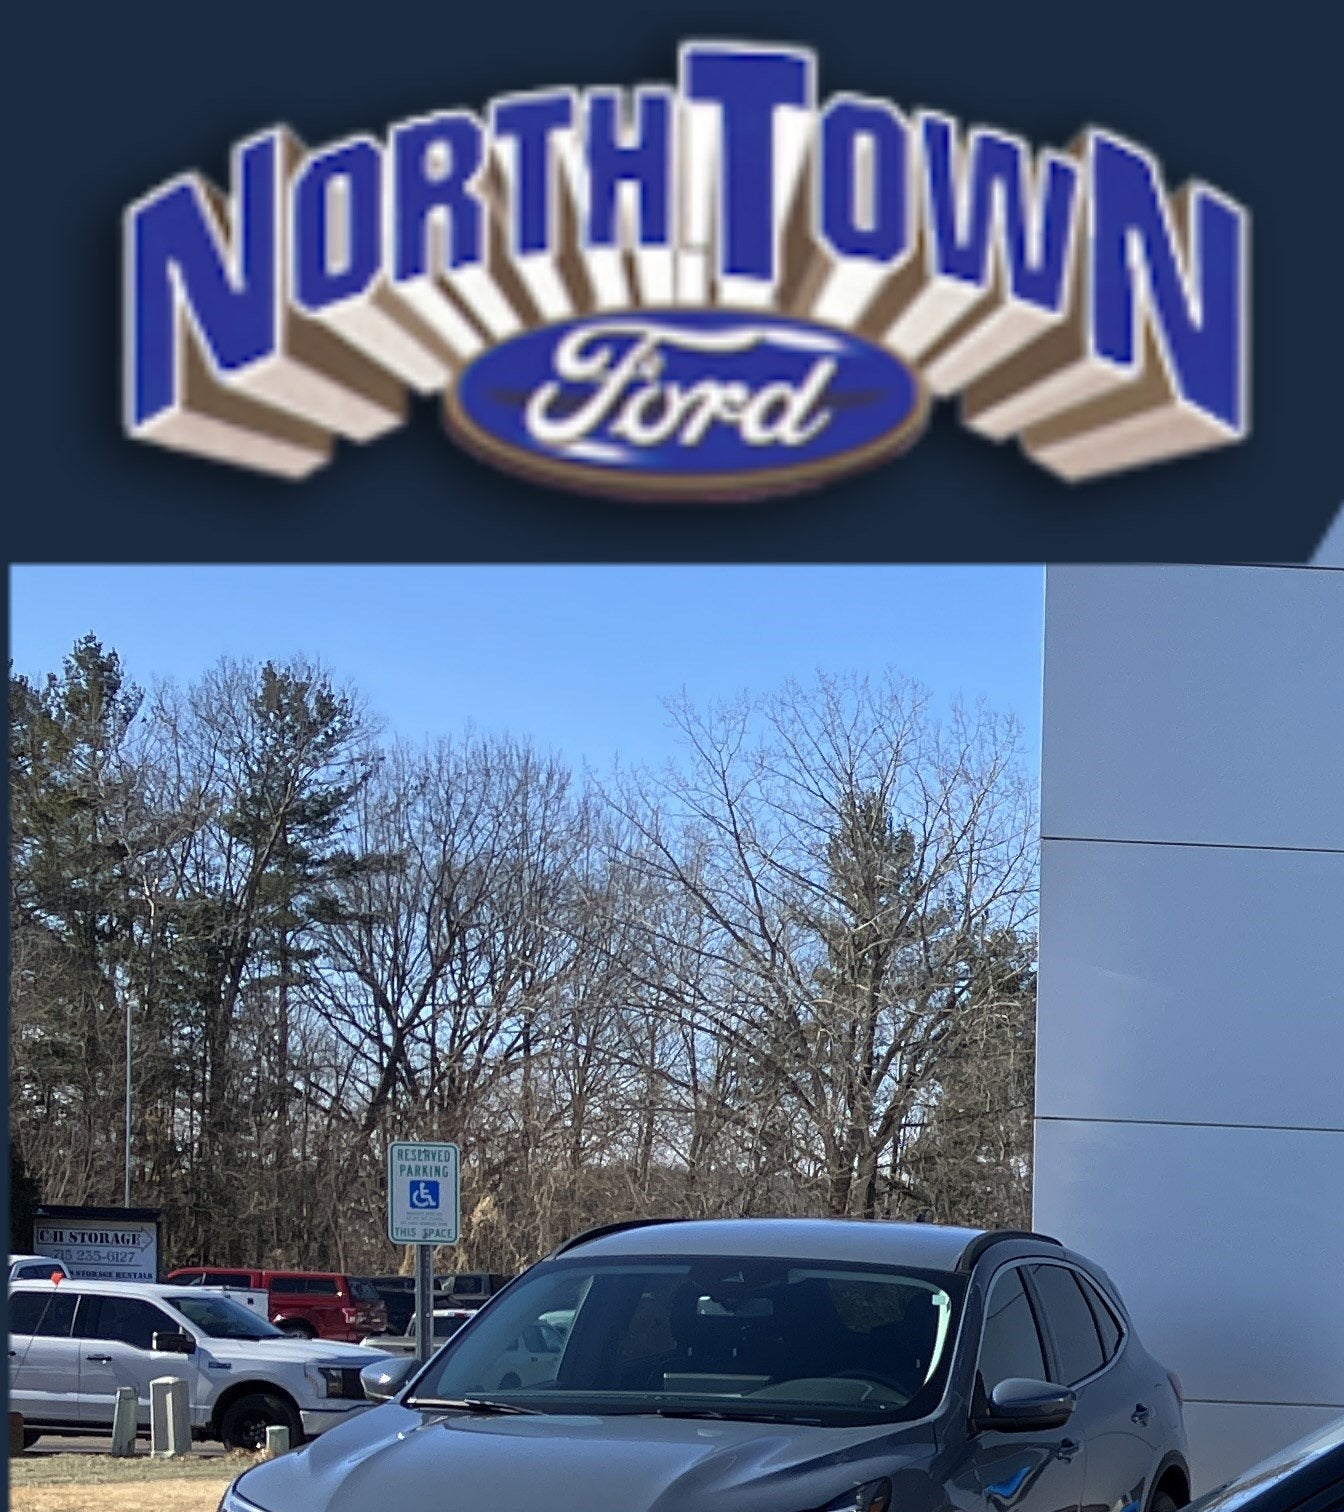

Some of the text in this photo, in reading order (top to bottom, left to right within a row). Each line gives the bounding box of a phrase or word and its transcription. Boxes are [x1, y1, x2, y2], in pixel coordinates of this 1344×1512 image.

[397, 1149, 451, 1163] RESERVED
[400, 1164, 449, 1178] PARKING
[68, 1232, 141, 1246] STORAGE
[395, 1227, 453, 1239] THIS SPACE
